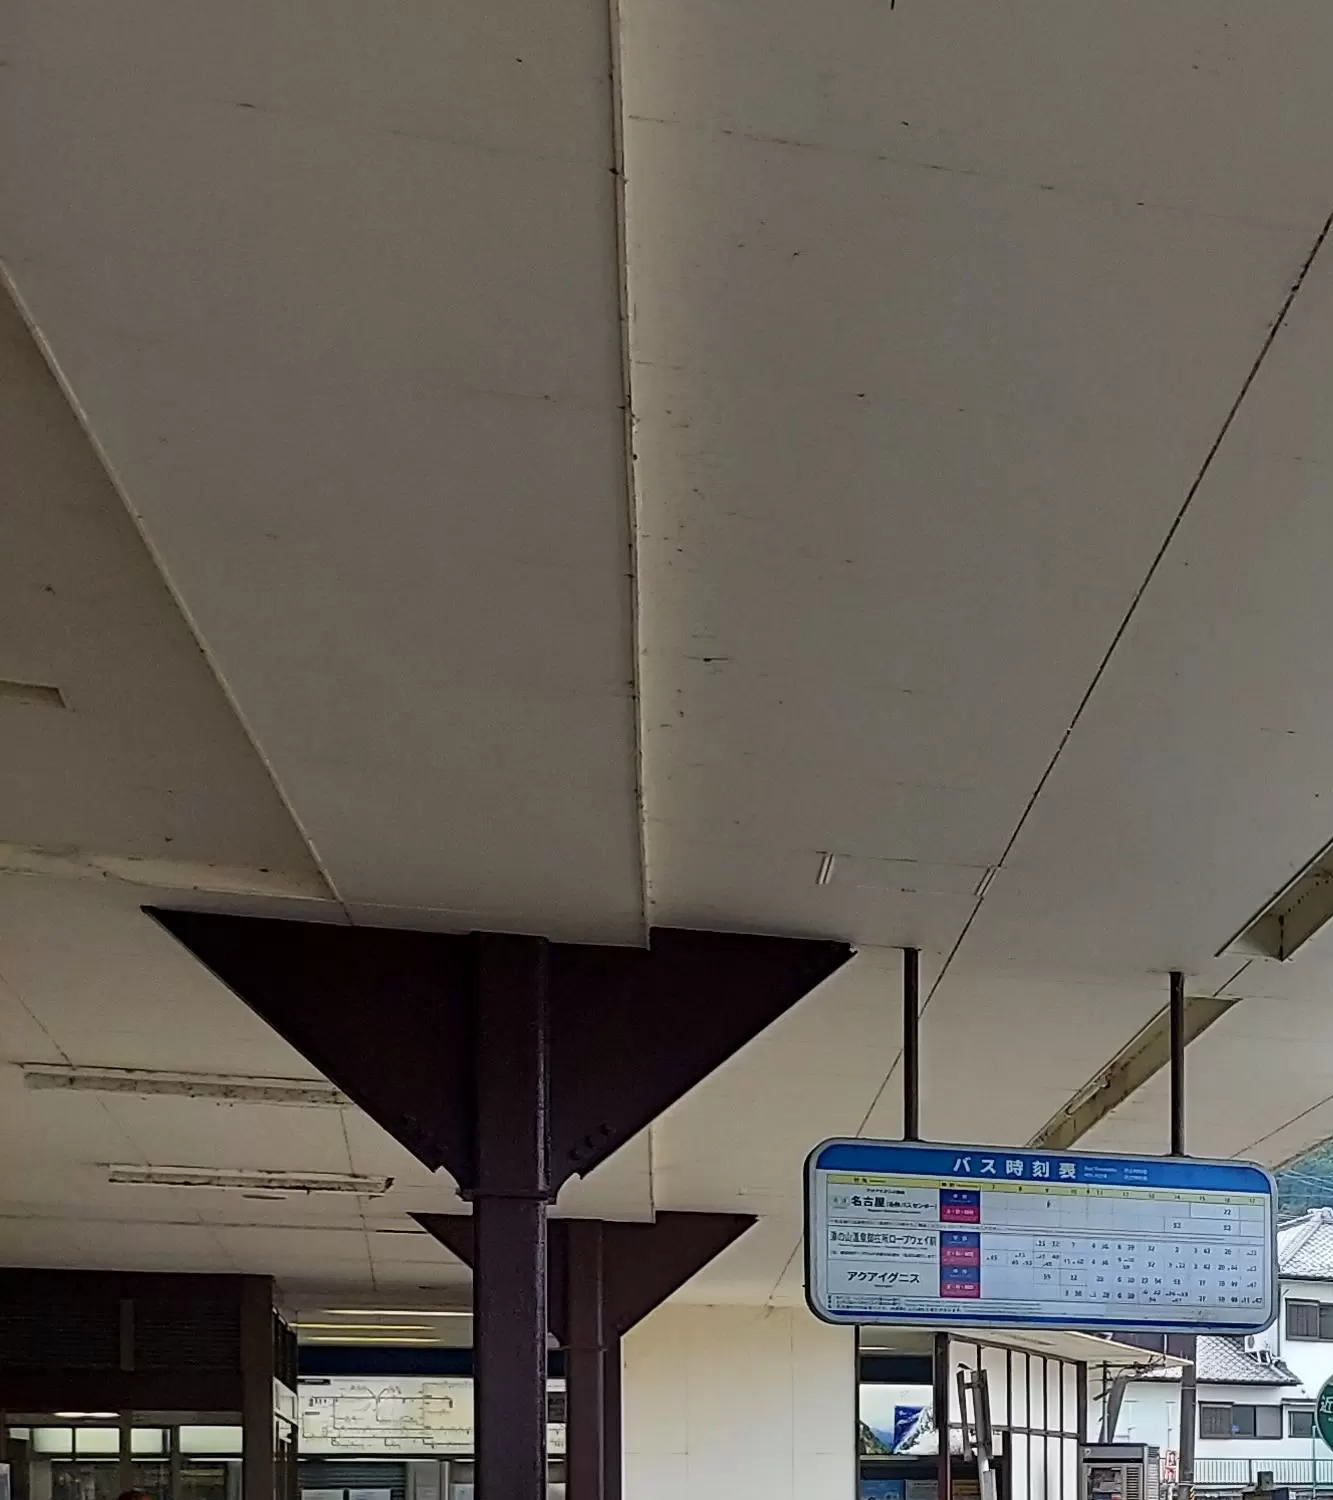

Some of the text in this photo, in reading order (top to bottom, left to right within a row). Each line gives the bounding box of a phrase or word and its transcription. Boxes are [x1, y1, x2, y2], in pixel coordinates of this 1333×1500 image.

[953, 1157, 1076, 1179] バス時刻表
[852, 1195, 885, 1208] 名古屋
[847, 1271, 920, 1284] アクアイグニス
